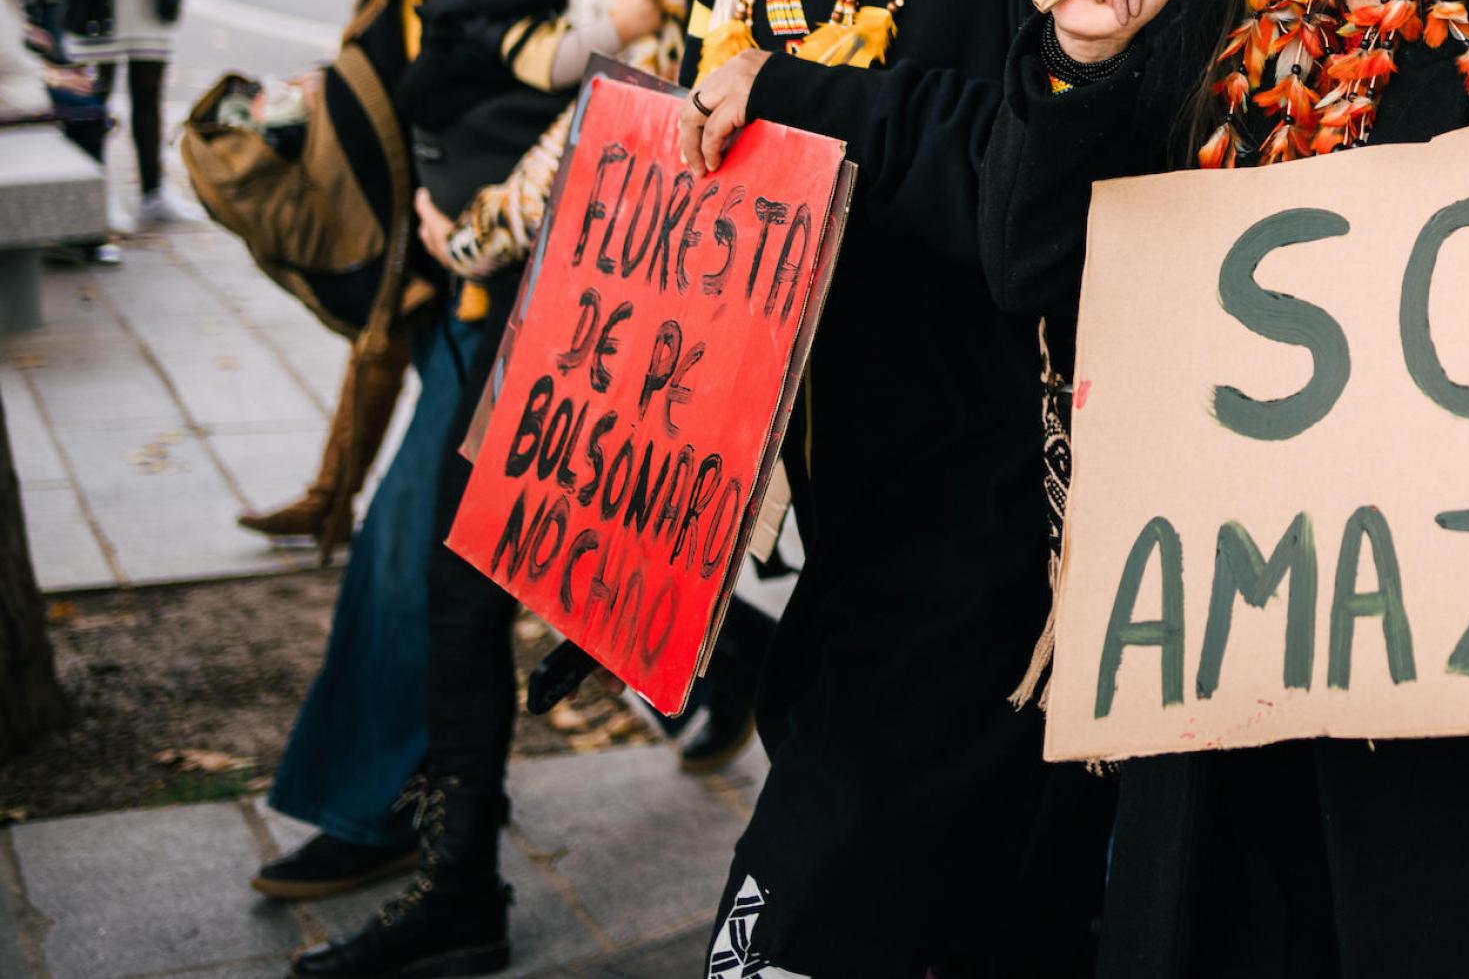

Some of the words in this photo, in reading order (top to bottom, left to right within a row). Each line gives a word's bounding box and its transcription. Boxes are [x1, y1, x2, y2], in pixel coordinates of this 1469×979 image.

[571, 142, 812, 322] FLORESTA
[557, 287, 634, 394] DE
[490, 490, 570, 584] NO
[504, 374, 743, 580] BOLSONARO
